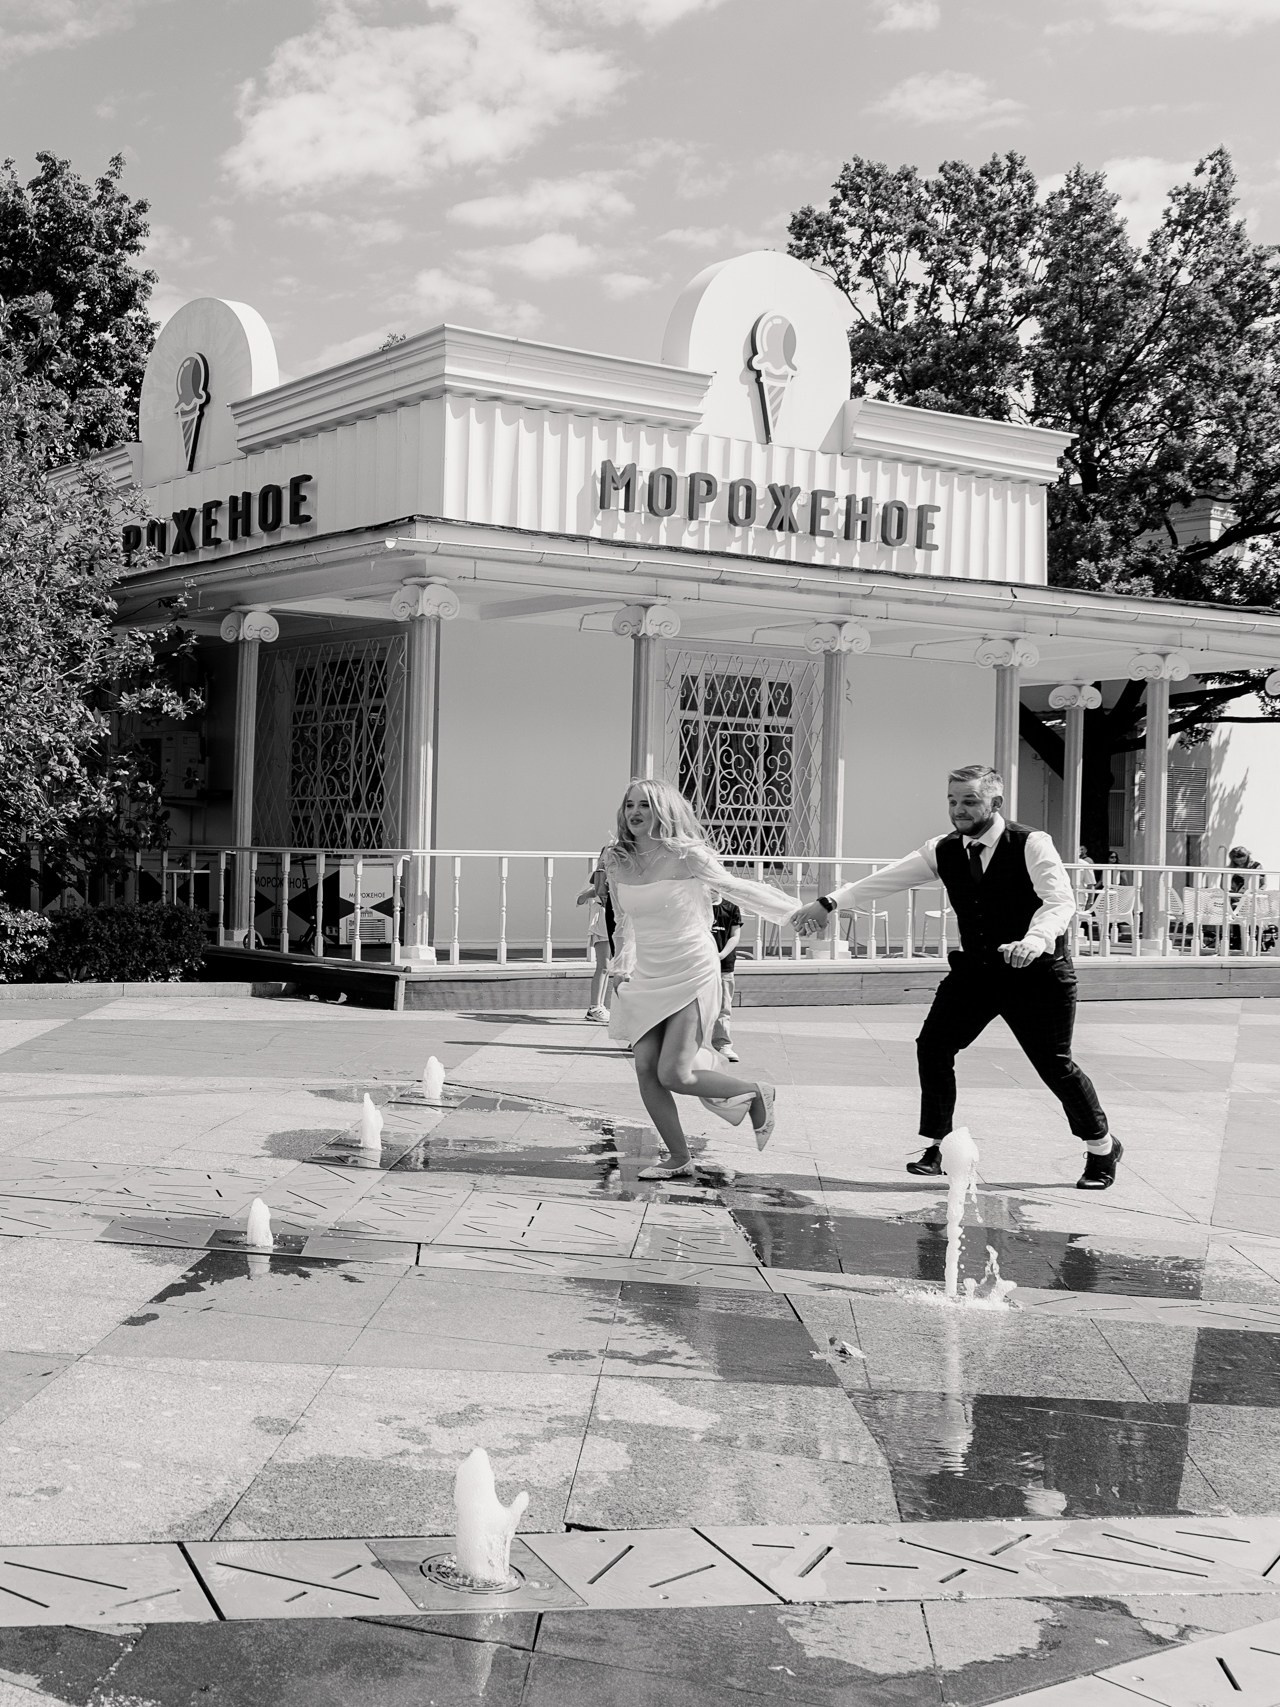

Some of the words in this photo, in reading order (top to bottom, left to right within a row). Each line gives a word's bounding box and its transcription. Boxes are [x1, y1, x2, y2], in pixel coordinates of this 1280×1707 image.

[122, 474, 313, 568] РОЖЕНОЕ
[599, 459, 941, 551] МОРОЖЕНОЕ
[255, 876, 307, 889] МОРОЖНОЕ
